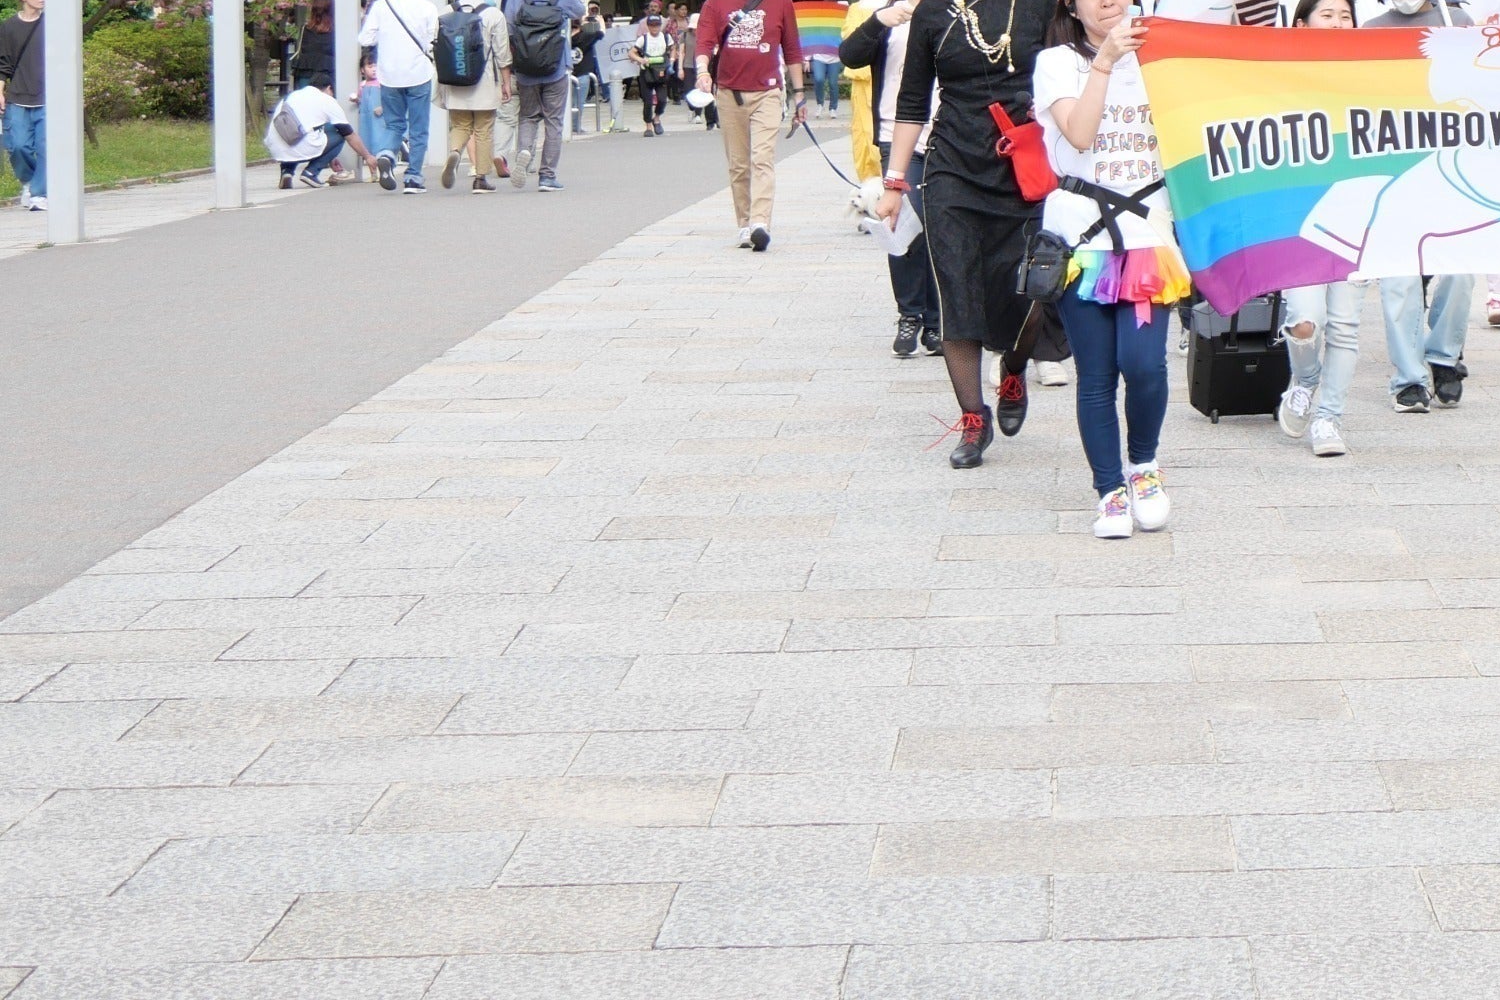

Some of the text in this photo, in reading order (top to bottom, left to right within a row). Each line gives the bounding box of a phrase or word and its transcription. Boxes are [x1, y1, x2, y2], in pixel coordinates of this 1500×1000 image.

[455, 35, 466, 77] ADIDAS
[1205, 112, 1329, 178] KYOTO
[1094, 159, 1159, 183] PRIDE
